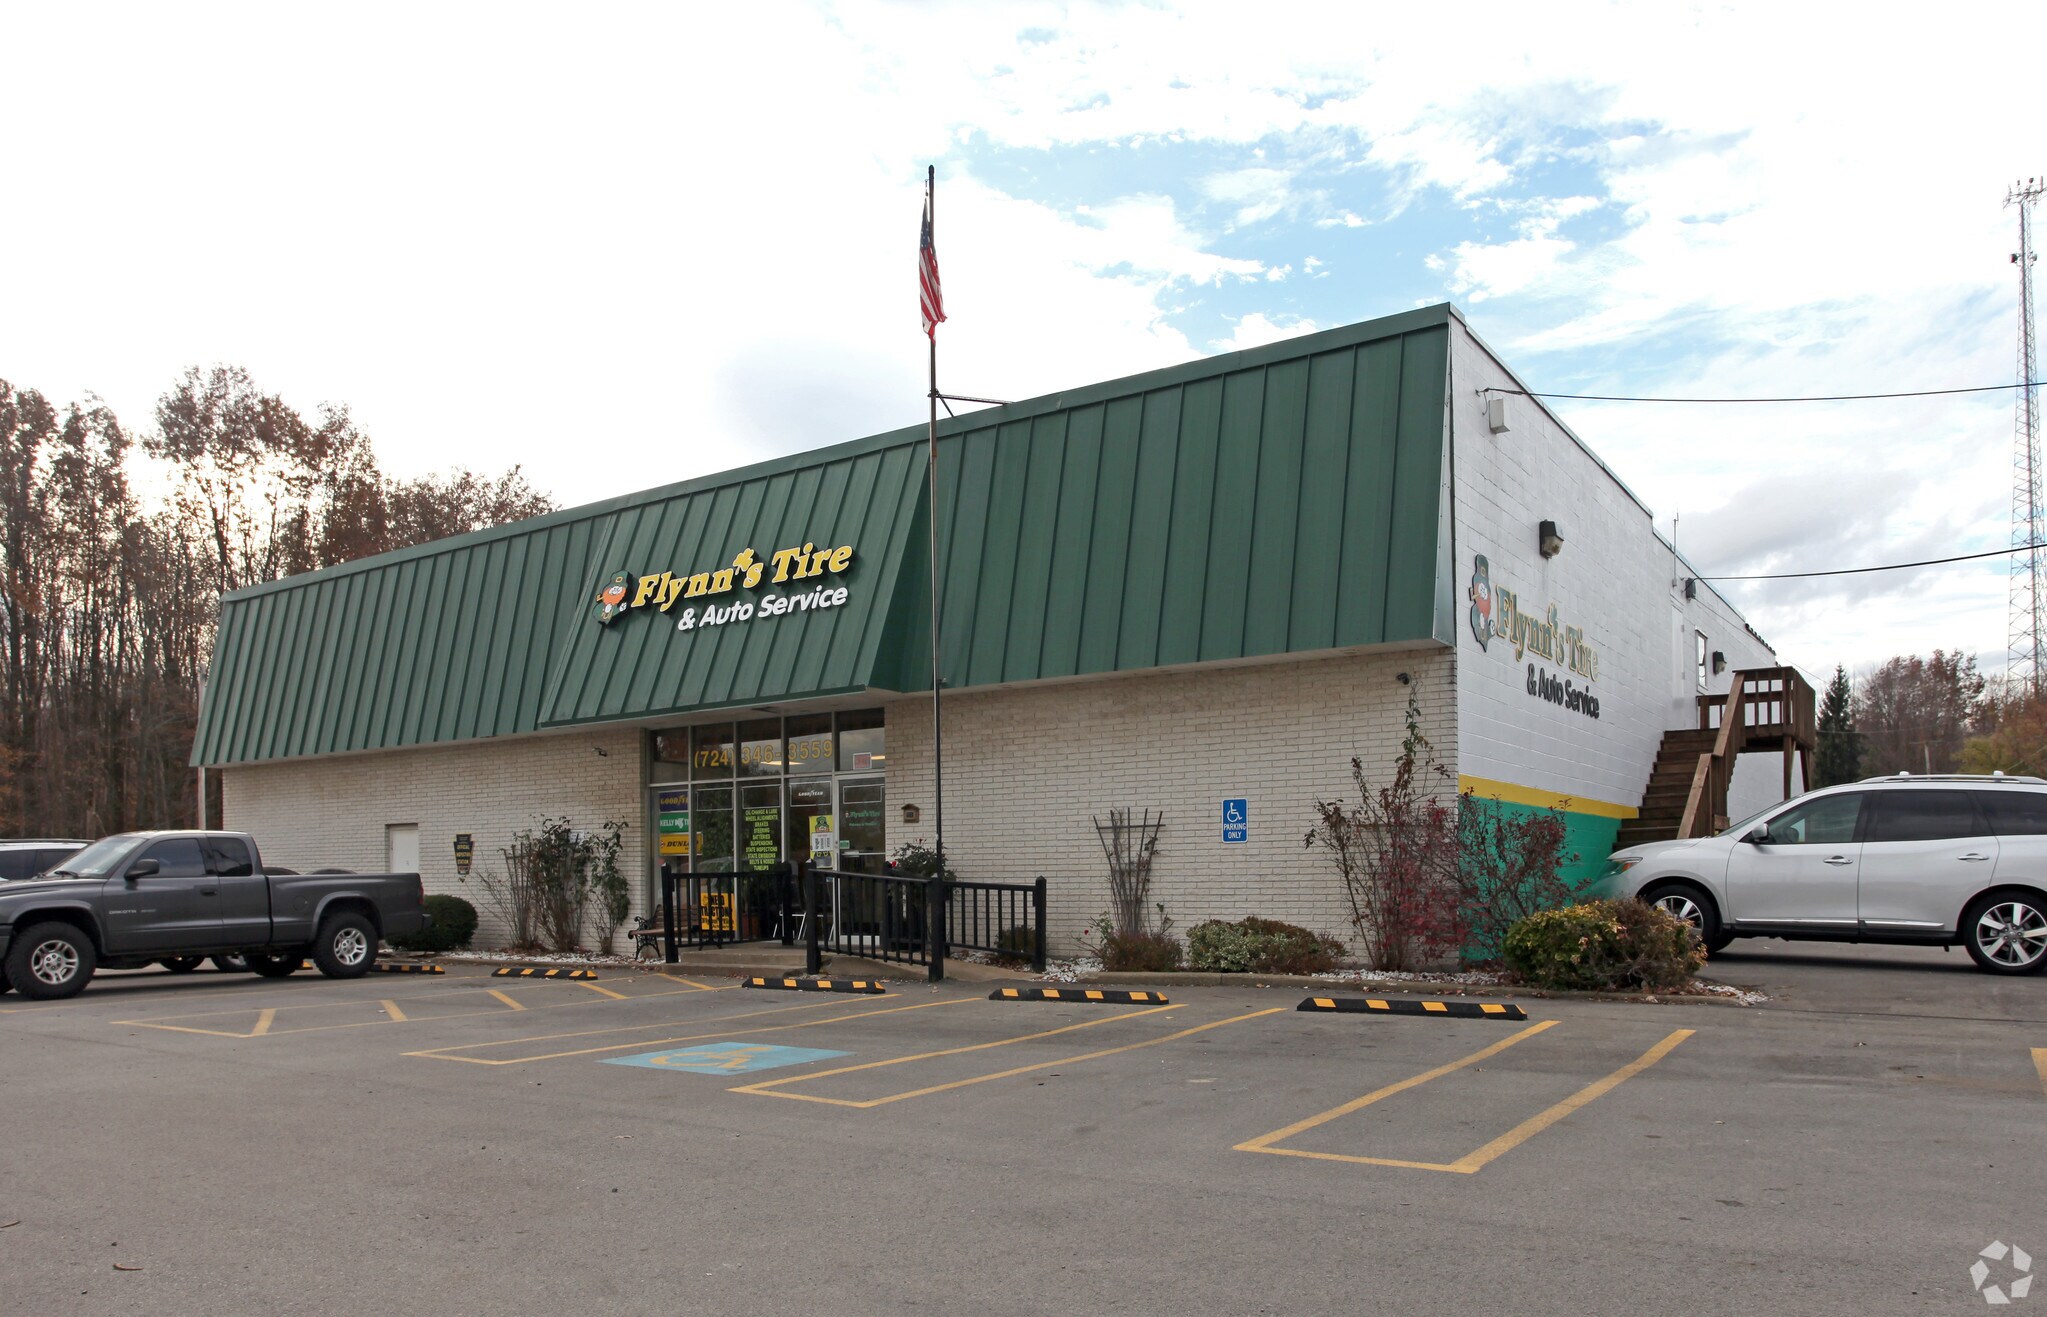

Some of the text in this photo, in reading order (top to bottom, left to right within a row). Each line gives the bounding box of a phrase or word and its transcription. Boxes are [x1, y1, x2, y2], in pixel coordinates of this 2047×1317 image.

[631, 542, 853, 612] Flynn's Tire
[678, 585, 848, 631] & Auto Service
[1496, 584, 1600, 682] Flynn's Tire
[1527, 663, 1600, 719] & Auto Service
[693, 748, 735, 769] (724)
[660, 818, 675, 827] KELLY
[1223, 822, 1247, 831] PARKING
[667, 840, 690, 848] DUNL
[1227, 831, 1242, 839] ONLY
